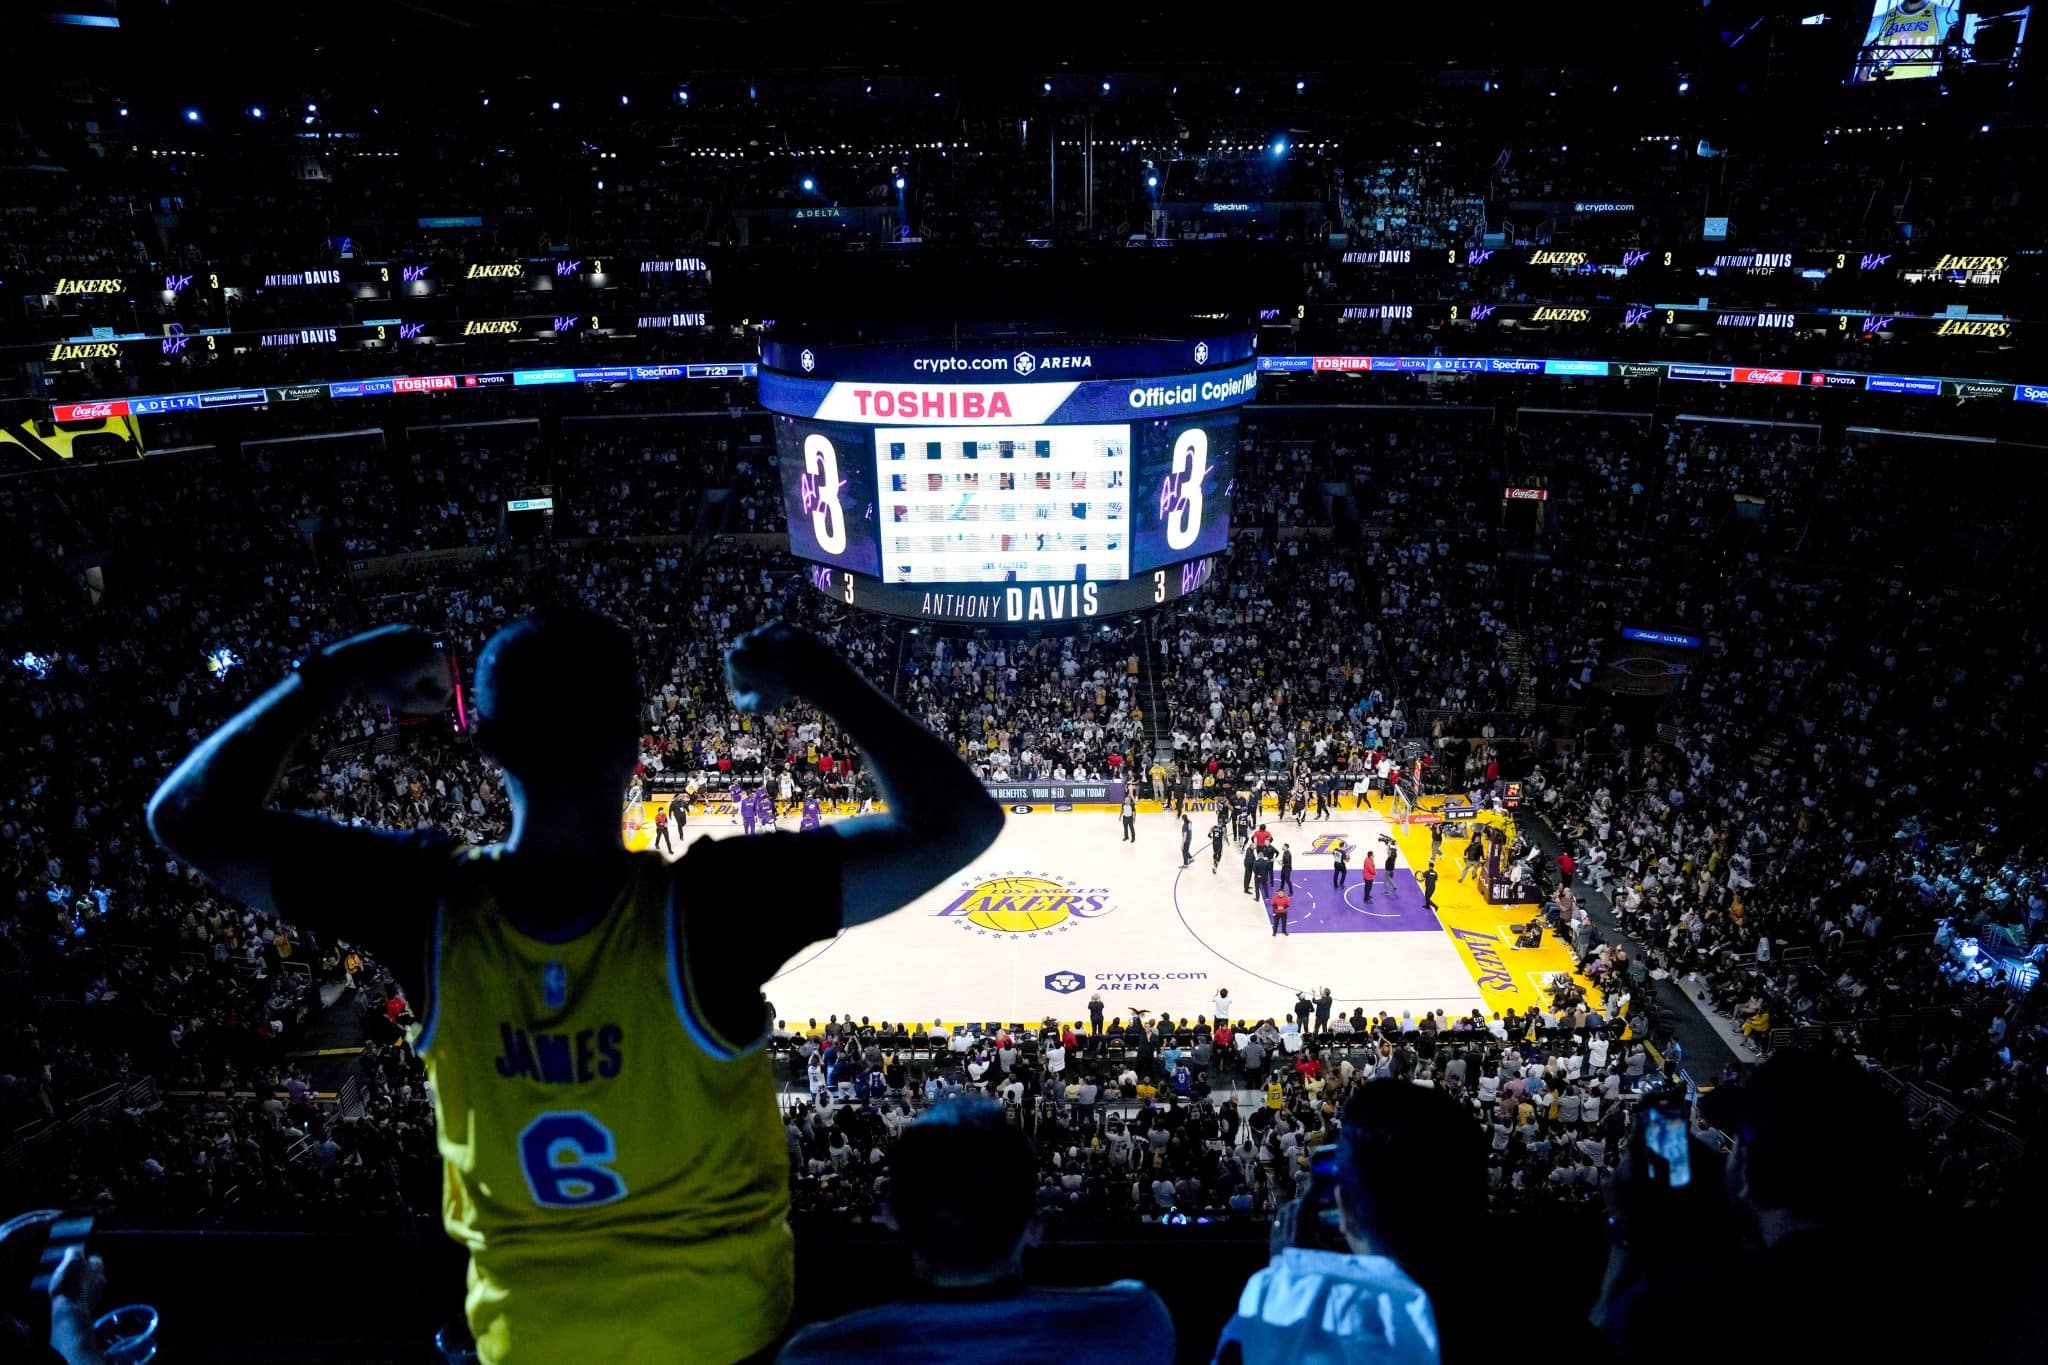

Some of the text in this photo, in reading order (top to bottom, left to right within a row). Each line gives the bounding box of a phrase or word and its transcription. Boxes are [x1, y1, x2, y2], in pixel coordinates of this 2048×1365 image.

[1885, 21, 1930, 38] LAKERS
[806, 209, 840, 217] DELTA
[1584, 202, 1635, 213] crypto.com
[1379, 250, 1411, 263] DAVIS
[1448, 250, 1456, 264] 3
[1529, 250, 1587, 265] LAKERS
[1663, 252, 1672, 266] 3
[1714, 253, 1792, 268] ANTHONY DAVIS
[1836, 254, 1846, 269] 3
[1935, 254, 2008, 271] LAKERS
[466, 264, 522, 279] LAKERS
[594, 260, 602, 273] 3
[640, 261, 675, 273] ANTHONY
[209, 273, 219, 289] 3
[265, 270, 341, 287] ANTHONY DAVIS
[380, 267, 389, 282] 3
[54, 278, 122, 296] LAKERS
[1297, 305, 1305, 319] 3
[1381, 305, 1413, 319] DAVIS
[1450, 305, 1458, 319] 3
[1532, 306, 1589, 321] LAKERS
[1666, 310, 1674, 324] 3
[463, 320, 519, 336] LAKERS
[591, 316, 599, 330] 3
[637, 313, 706, 329] ANTHONY DAVIS
[1716, 314, 1795, 328] ANTHONY DAVIS
[1839, 316, 1847, 331] 3
[377, 326, 386, 340] 3
[1937, 320, 2011, 337] LAKERS
[206, 335, 216, 350] 3
[261, 328, 337, 347] ANTHONY DAVIS
[51, 343, 119, 361] LAKERS
[914, 354, 1093, 373] crypto.com ARENA
[1272, 359, 1308, 368] crypto.com
[1316, 359, 1368, 369] TOSHIBA
[1401, 360, 1426, 368] ULTRA
[1445, 360, 1482, 369] DELTA
[1493, 360, 1538, 372] Spectrum
[577, 371, 602, 379] AMERICAN
[636, 367, 680, 379] Spectrum
[703, 366, 728, 376] 7:29
[365, 382, 391, 392] ULTRA
[397, 378, 452, 390] TOSHIBA
[478, 376, 505, 384] TOYOTA
[1826, 376, 1856, 385] TOYOTA
[1872, 380, 1936, 390] AMERICAN EXPRESS
[1128, 383, 1197, 408] Official
[150, 398, 195, 410] DELTA
[853, 389, 1014, 418] TOSHIBA
[804, 434, 847, 555] 3
[1166, 428, 1208, 550] 3
[844, 572, 855, 604] 3
[1154, 570, 1166, 603] 3
[921, 582, 1098, 622] ANTHONY DAVIS
[1663, 634, 1689, 644] ULTRA
[1032, 788, 1049, 798] YOUR
[1070, 788, 1086, 798] JOIN
[1086, 788, 1106, 798] TODAY
[1015, 805, 1027, 814] 6
[936, 889, 1112, 918] LAKERS
[1449, 927, 1519, 993] LAKERS
[1095, 971, 1208, 983] crypto.com
[1097, 983, 1160, 991] ARENA
[495, 1021, 623, 1084] JAMES
[1271, 1092, 1281, 1100] 23
[516, 1109, 630, 1208] 6
